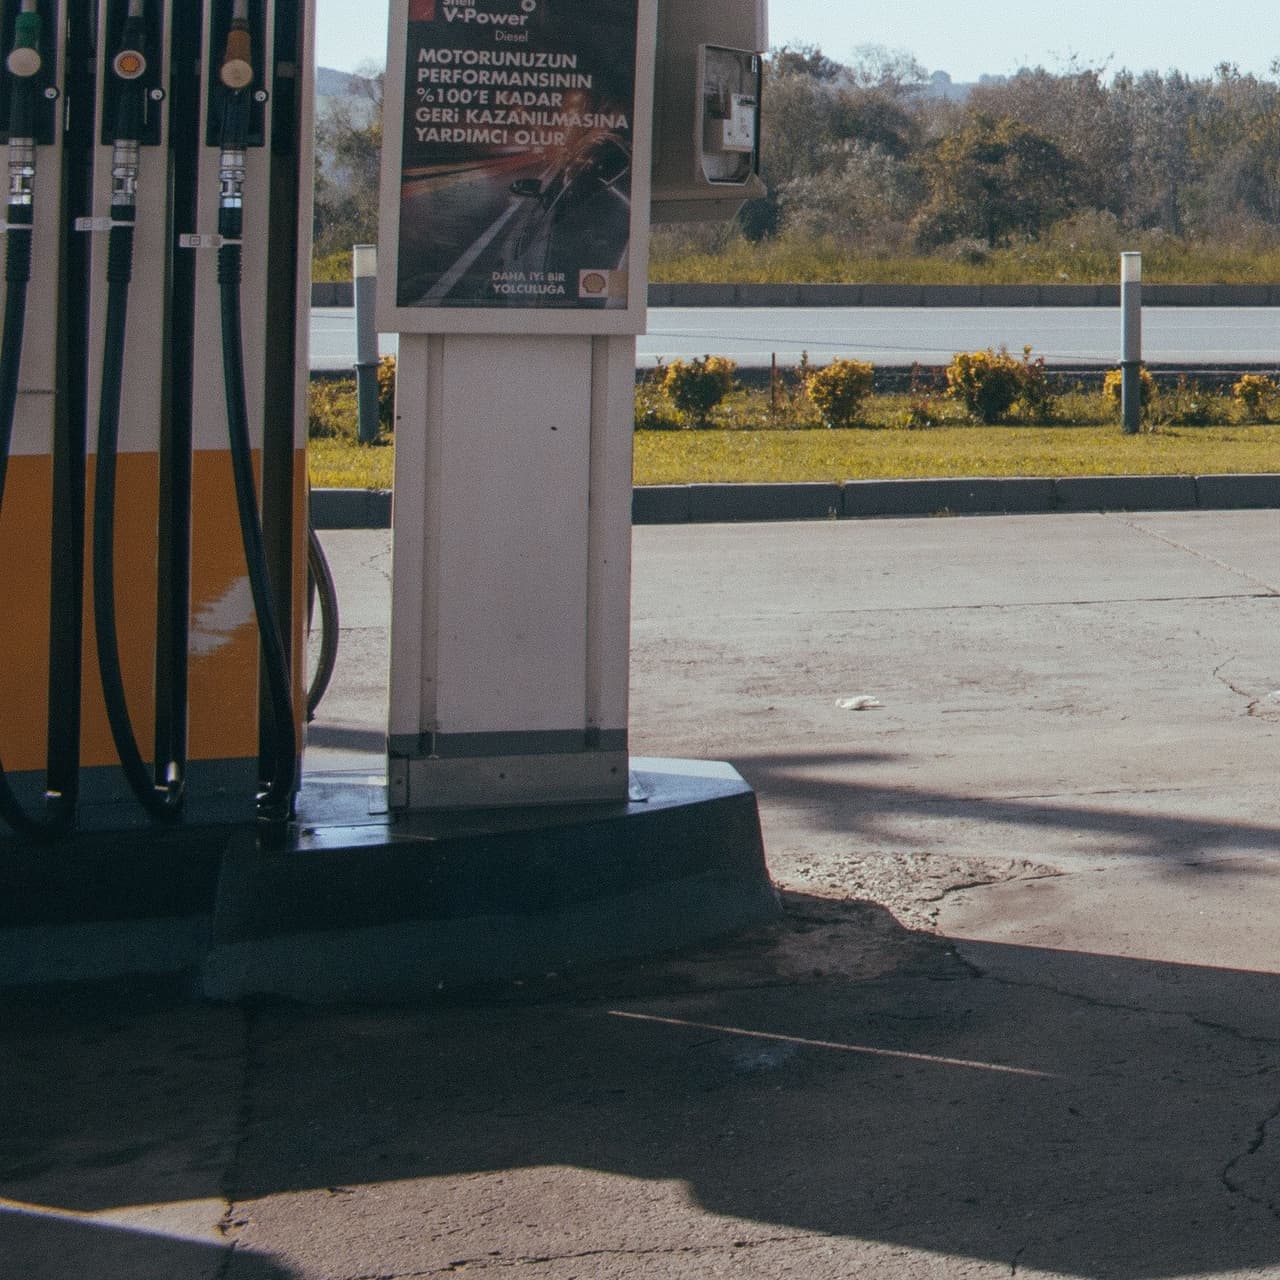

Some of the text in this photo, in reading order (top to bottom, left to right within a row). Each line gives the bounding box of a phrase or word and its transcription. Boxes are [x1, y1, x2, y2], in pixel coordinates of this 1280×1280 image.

[443, 8, 528, 26] V-Power
[495, 30, 529, 42] Diesel
[418, 48, 577, 69] MOTORUNUZUN
[417, 68, 592, 89] PERFORMANSININ
[495, 90, 563, 107] KADAR
[466, 109, 629, 129] KAZANILMASINA
[415, 127, 566, 145] YARDIMCI OLUR
[492, 271, 525, 282] DAHA
[493, 283, 566, 295] YOLCULUĞA
